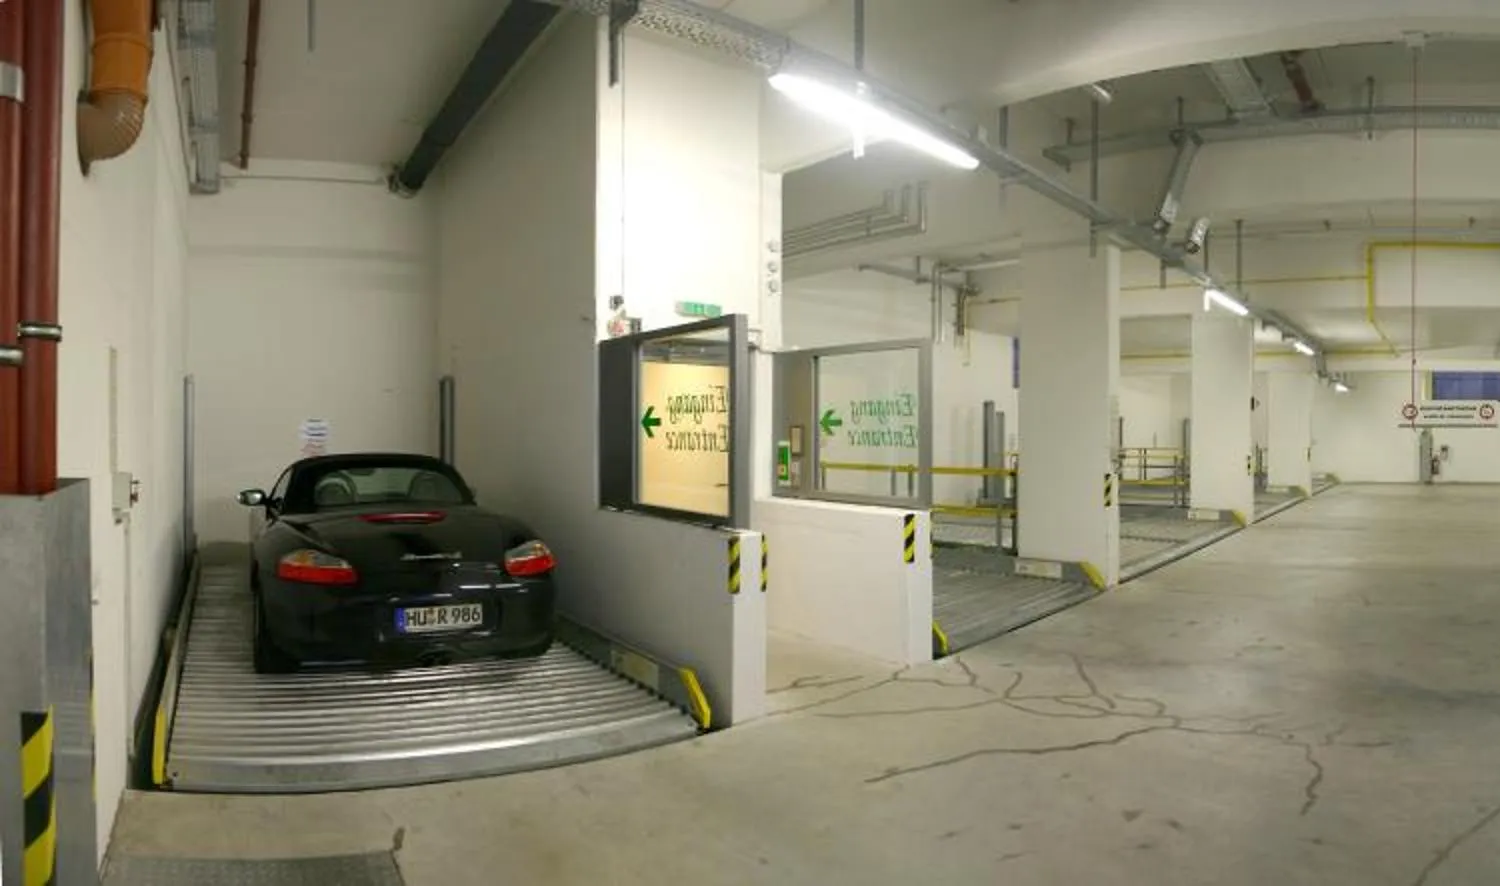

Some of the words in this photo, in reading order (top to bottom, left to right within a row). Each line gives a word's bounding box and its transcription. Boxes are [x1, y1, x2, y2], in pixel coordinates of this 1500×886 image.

[407, 608, 427, 627] HU
[437, 606, 448, 625] R
[452, 606, 480, 624] 986
